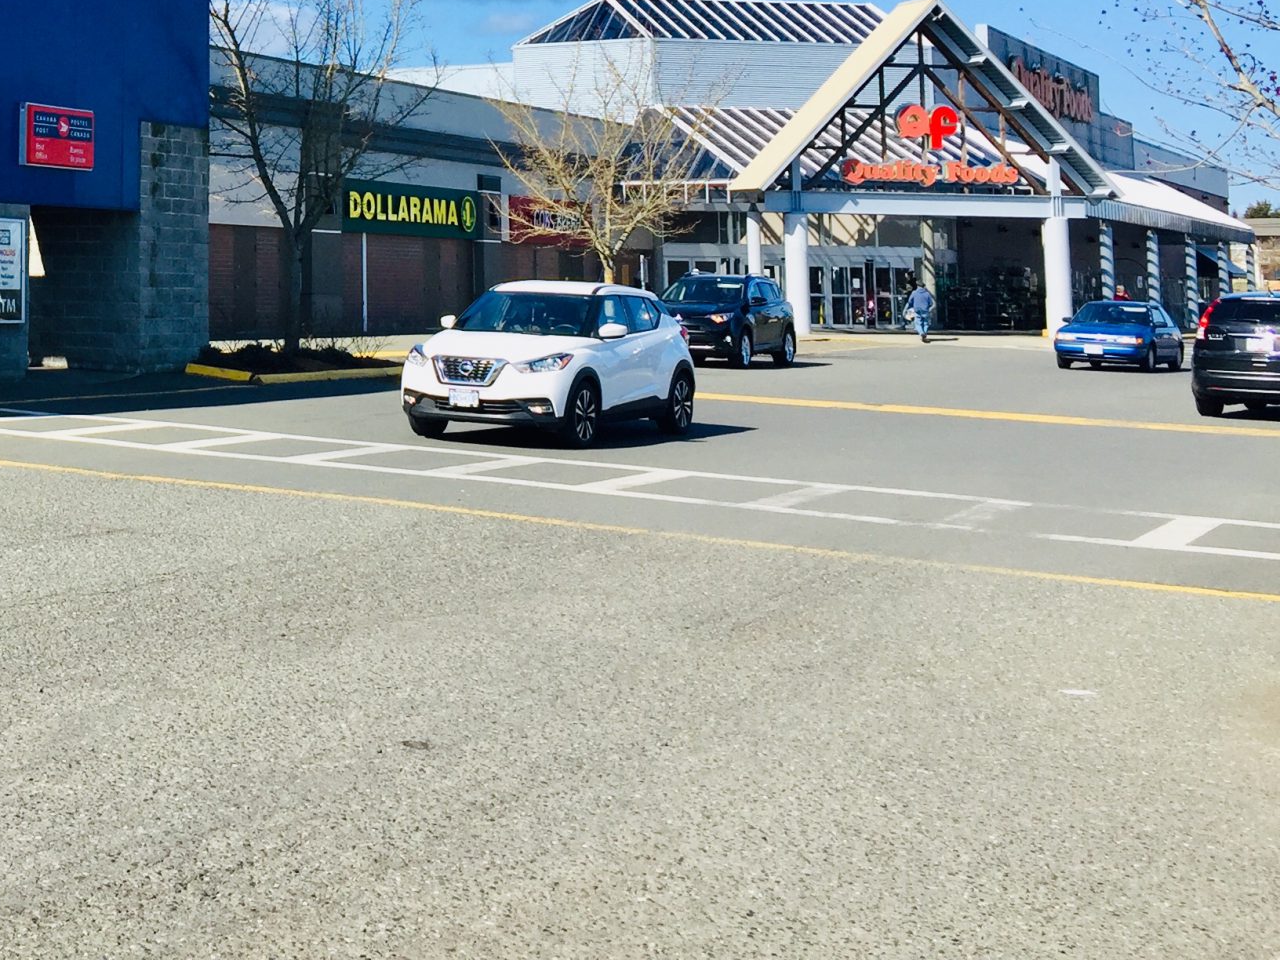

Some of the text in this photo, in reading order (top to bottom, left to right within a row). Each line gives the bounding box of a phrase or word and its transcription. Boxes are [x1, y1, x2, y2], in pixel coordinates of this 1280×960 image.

[840, 159, 1019, 187] Quality Foods
[349, 190, 459, 226] DOLLARAMA
